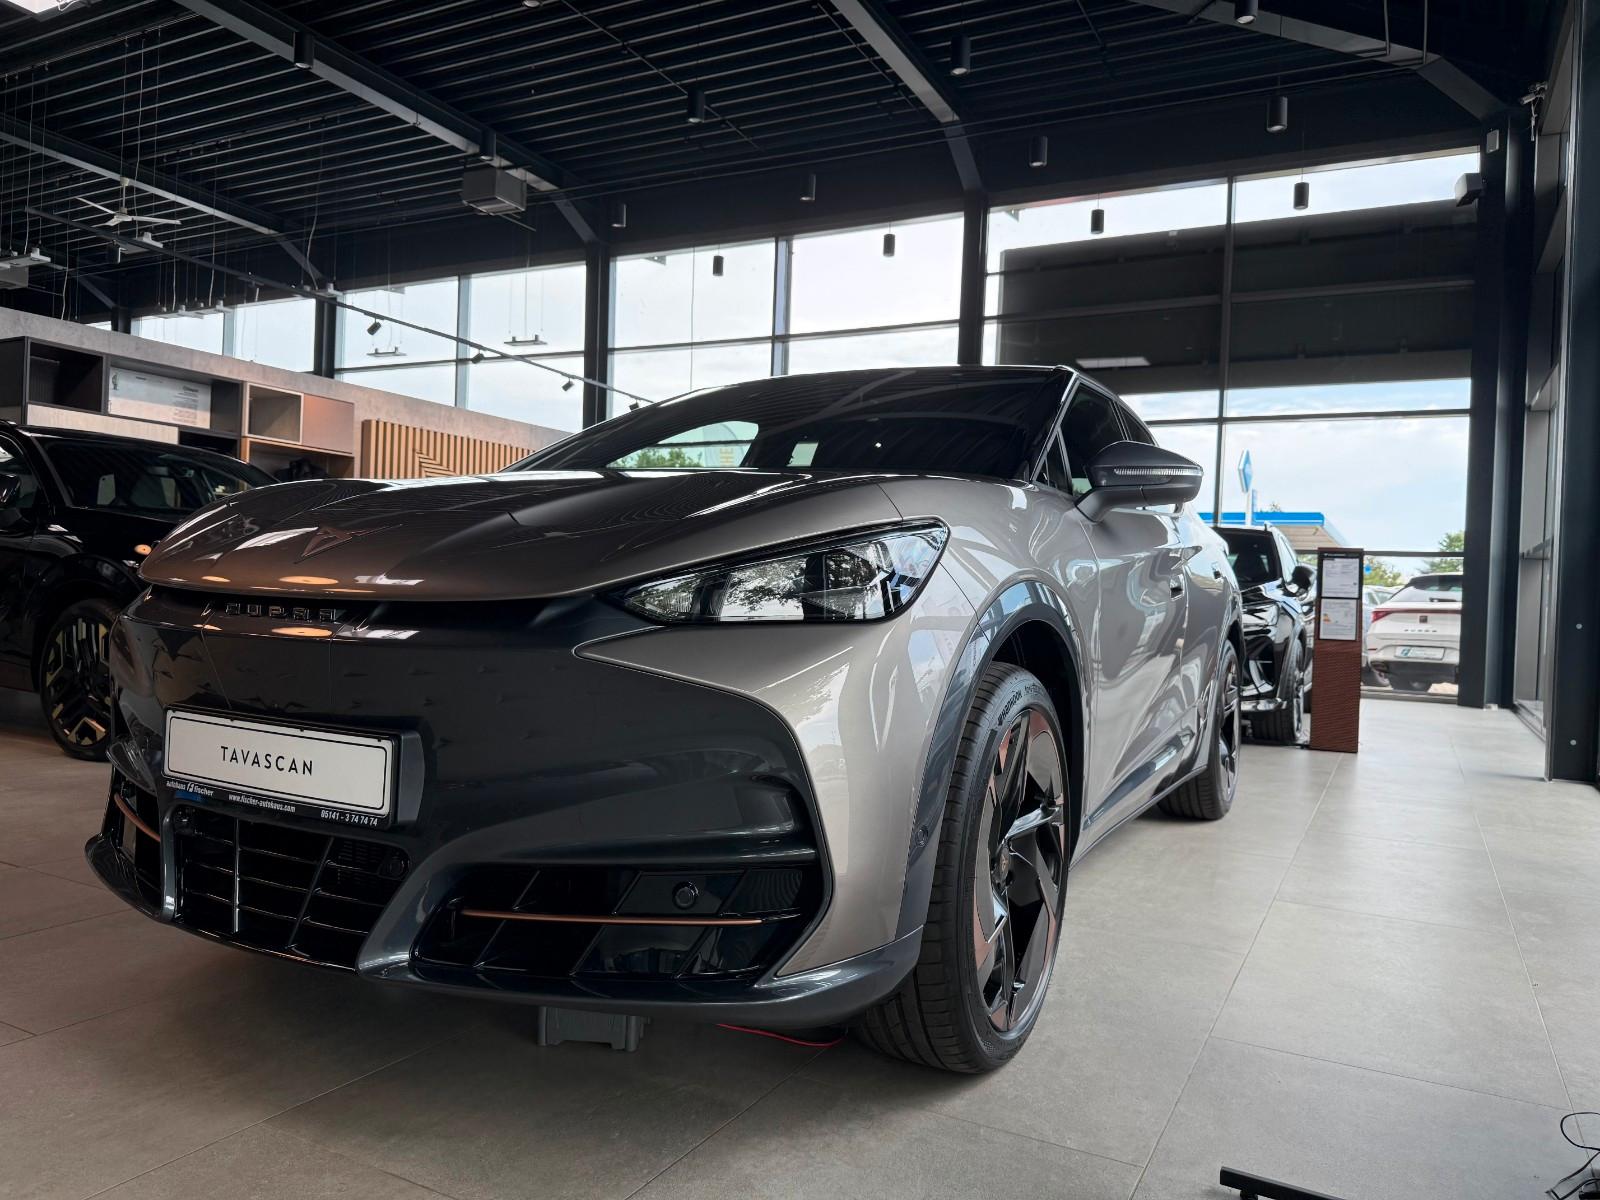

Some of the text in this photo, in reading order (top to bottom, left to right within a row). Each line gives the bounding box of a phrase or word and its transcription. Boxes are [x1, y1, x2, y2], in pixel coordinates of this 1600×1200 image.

[221, 746, 313, 776] TAVASCAN
[194, 786, 214, 796] fischer
[228, 794, 296, 813] www.fischer-autohaus.com
[320, 810, 339, 820] 05141
[345, 814, 350, 822] 3
[351, 815, 359, 823] 74
[360, 816, 369, 825] 74
[369, 818, 378, 826] 74
